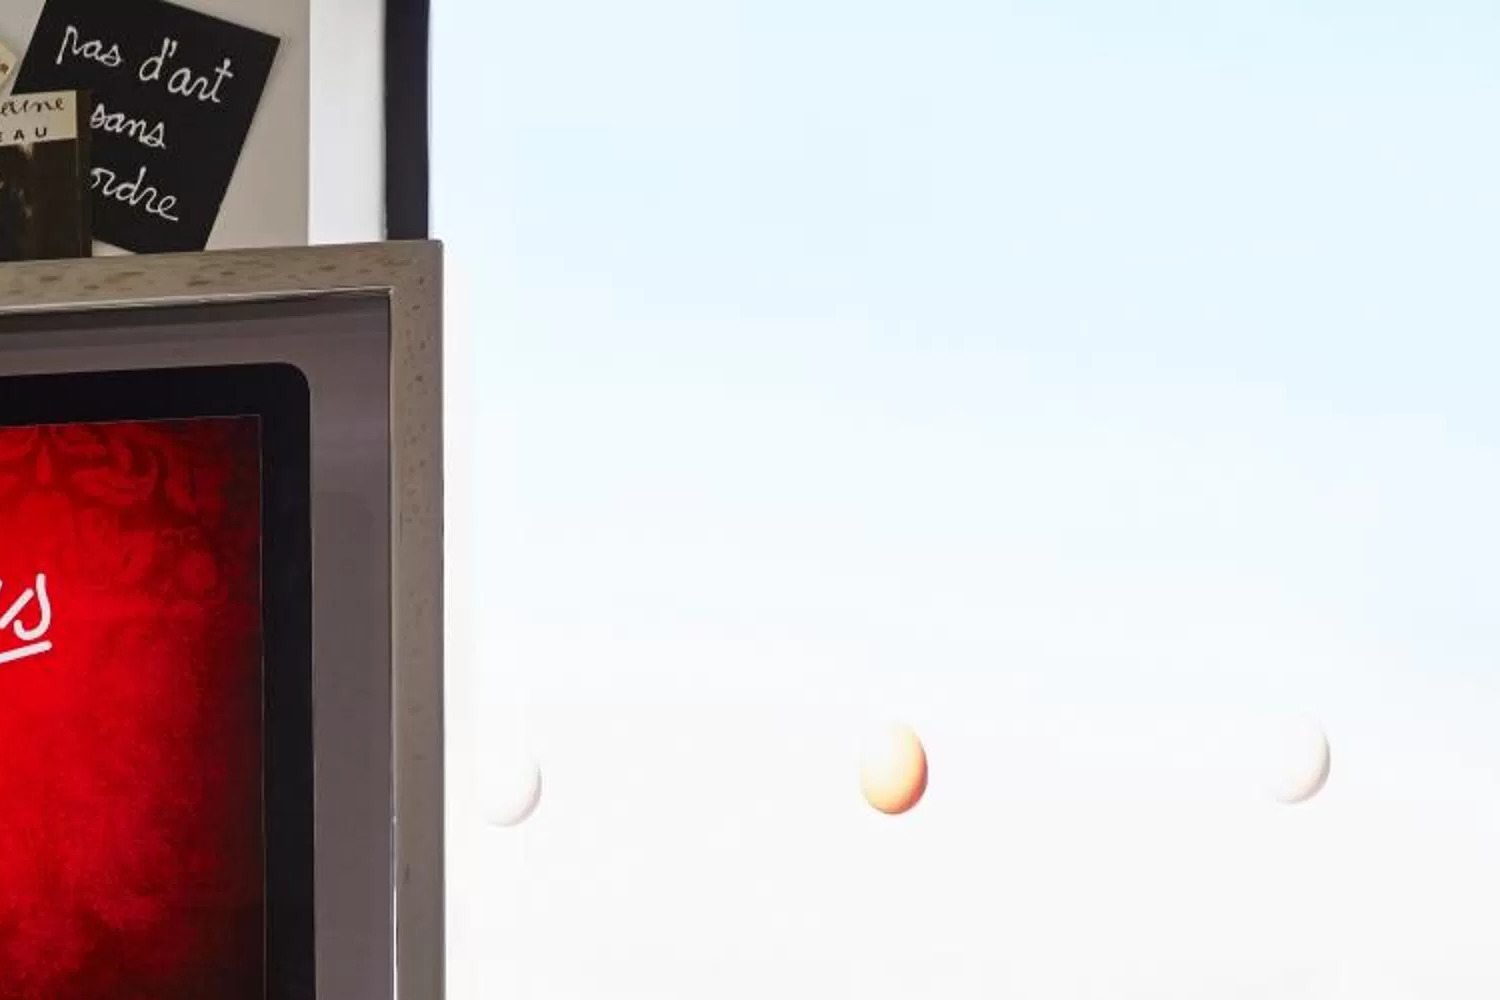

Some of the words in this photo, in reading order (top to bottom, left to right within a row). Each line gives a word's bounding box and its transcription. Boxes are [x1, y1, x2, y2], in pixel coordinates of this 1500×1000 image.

[56, 25, 124, 67] pas
[139, 37, 234, 103] d'art
[89, 103, 167, 149] sans
[90, 166, 180, 222] rdre
